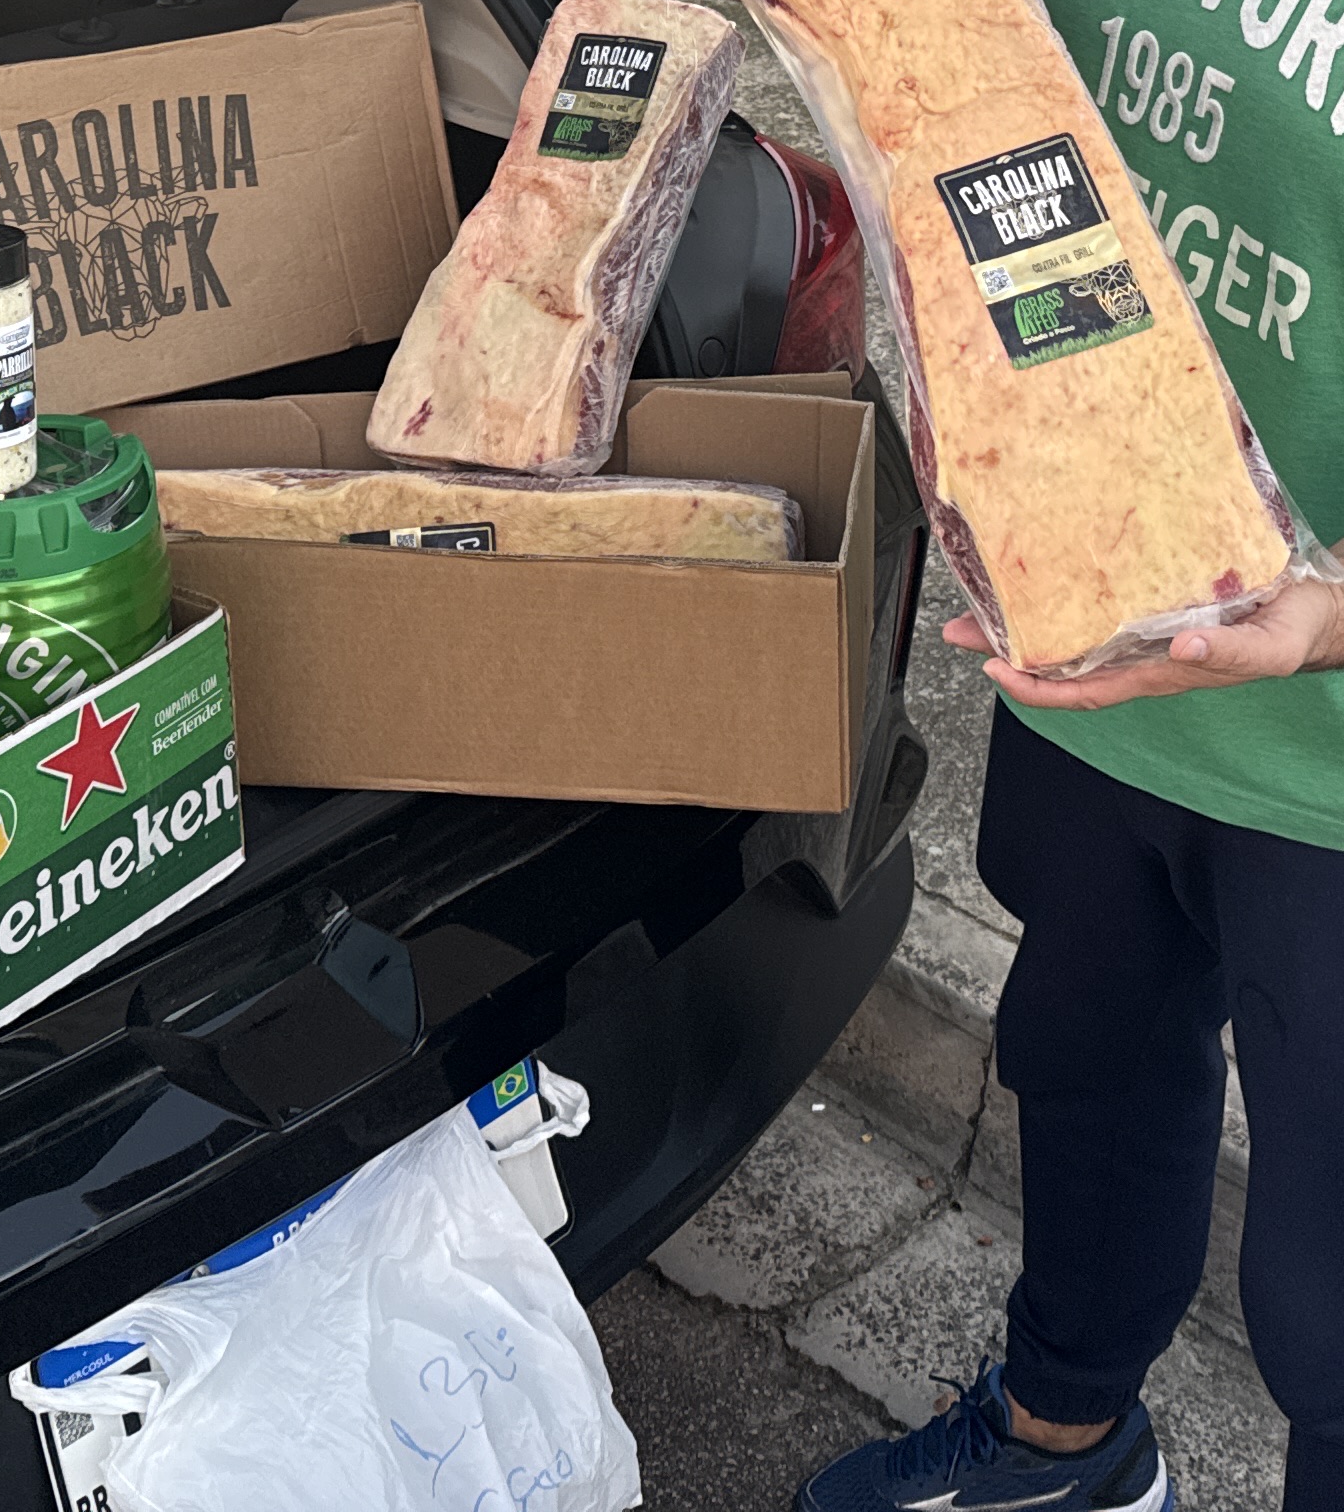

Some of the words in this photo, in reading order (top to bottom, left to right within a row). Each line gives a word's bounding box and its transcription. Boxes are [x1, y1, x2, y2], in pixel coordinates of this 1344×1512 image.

[580, 45, 654, 72] CAROLINA
[585, 67, 636, 91] BLACK
[1095, 16, 1236, 164] 1985
[958, 154, 1075, 215] CAROLINA
[992, 194, 1071, 246] BLACK
[27, 212, 232, 350] BLACK
[1019, 288, 1065, 317] GRASS
[151, 698, 223, 757] BeerTender
[154, 688, 200, 728] COMPATÍVEL
[200, 674, 218, 696] COM
[63, 1353, 114, 1386] MERCOSUL
